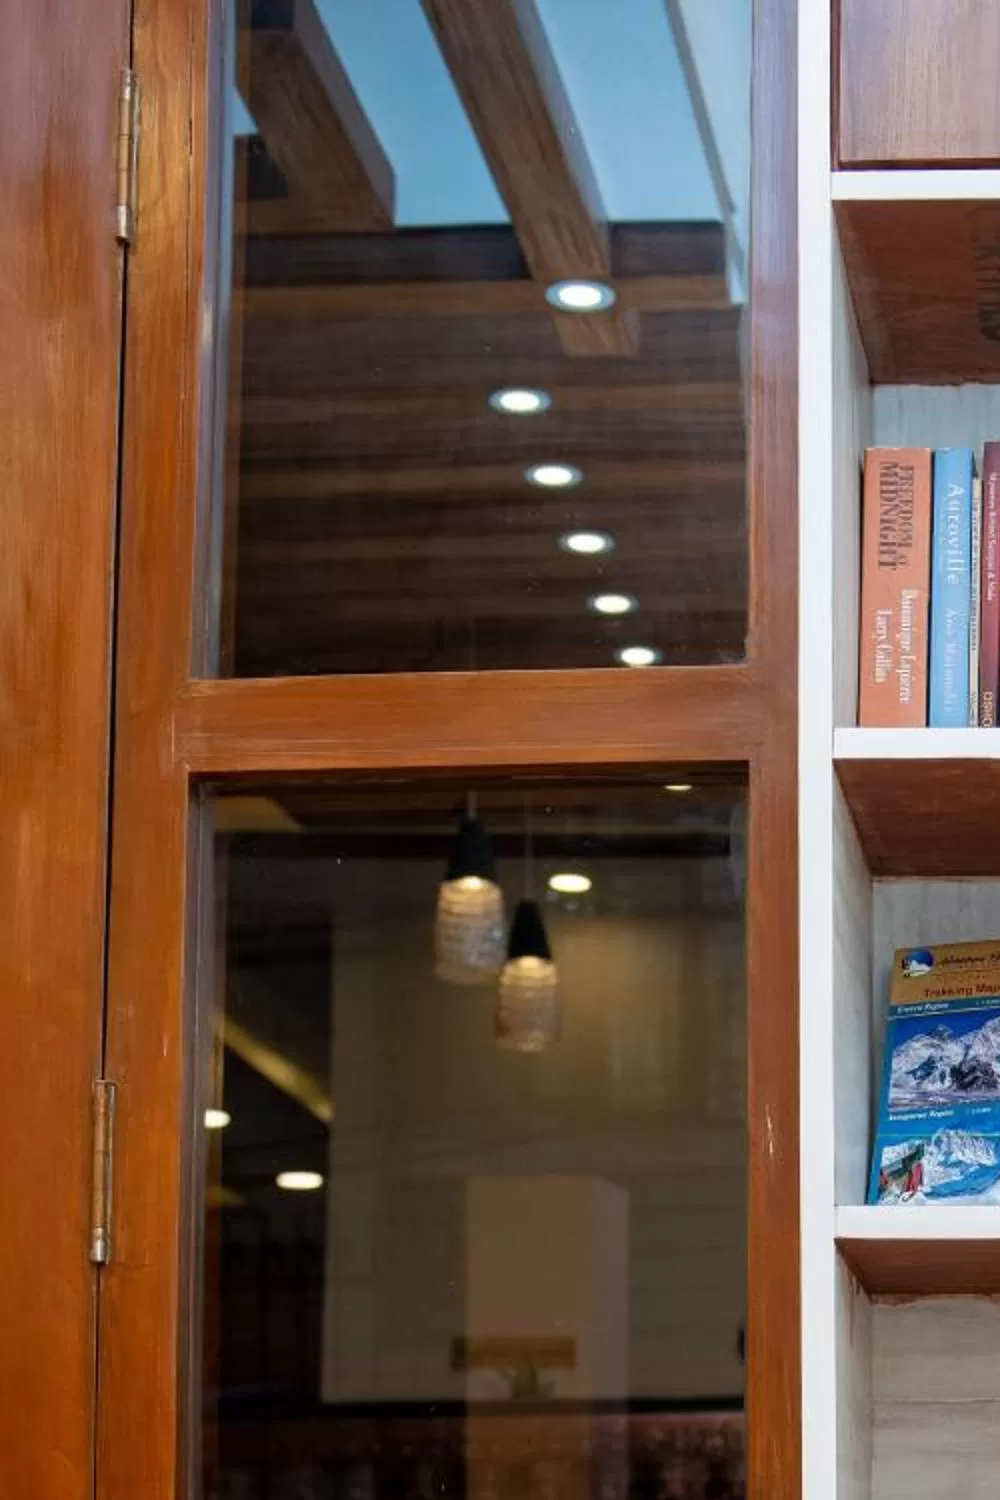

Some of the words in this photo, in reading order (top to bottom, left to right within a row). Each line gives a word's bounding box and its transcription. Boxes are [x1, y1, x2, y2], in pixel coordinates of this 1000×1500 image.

[878, 461, 899, 571] MIDNIGHT
[899, 465, 915, 549] FREEDOM
[947, 483, 965, 585] Auroville
[871, 608, 892, 643] Larry
[897, 589, 918, 652] Dominique
[875, 644, 894, 683] Collins
[897, 654, 917, 704] Lapierre
[924, 986, 973, 998] Trekking
[976, 983, 1000, 995] Map
